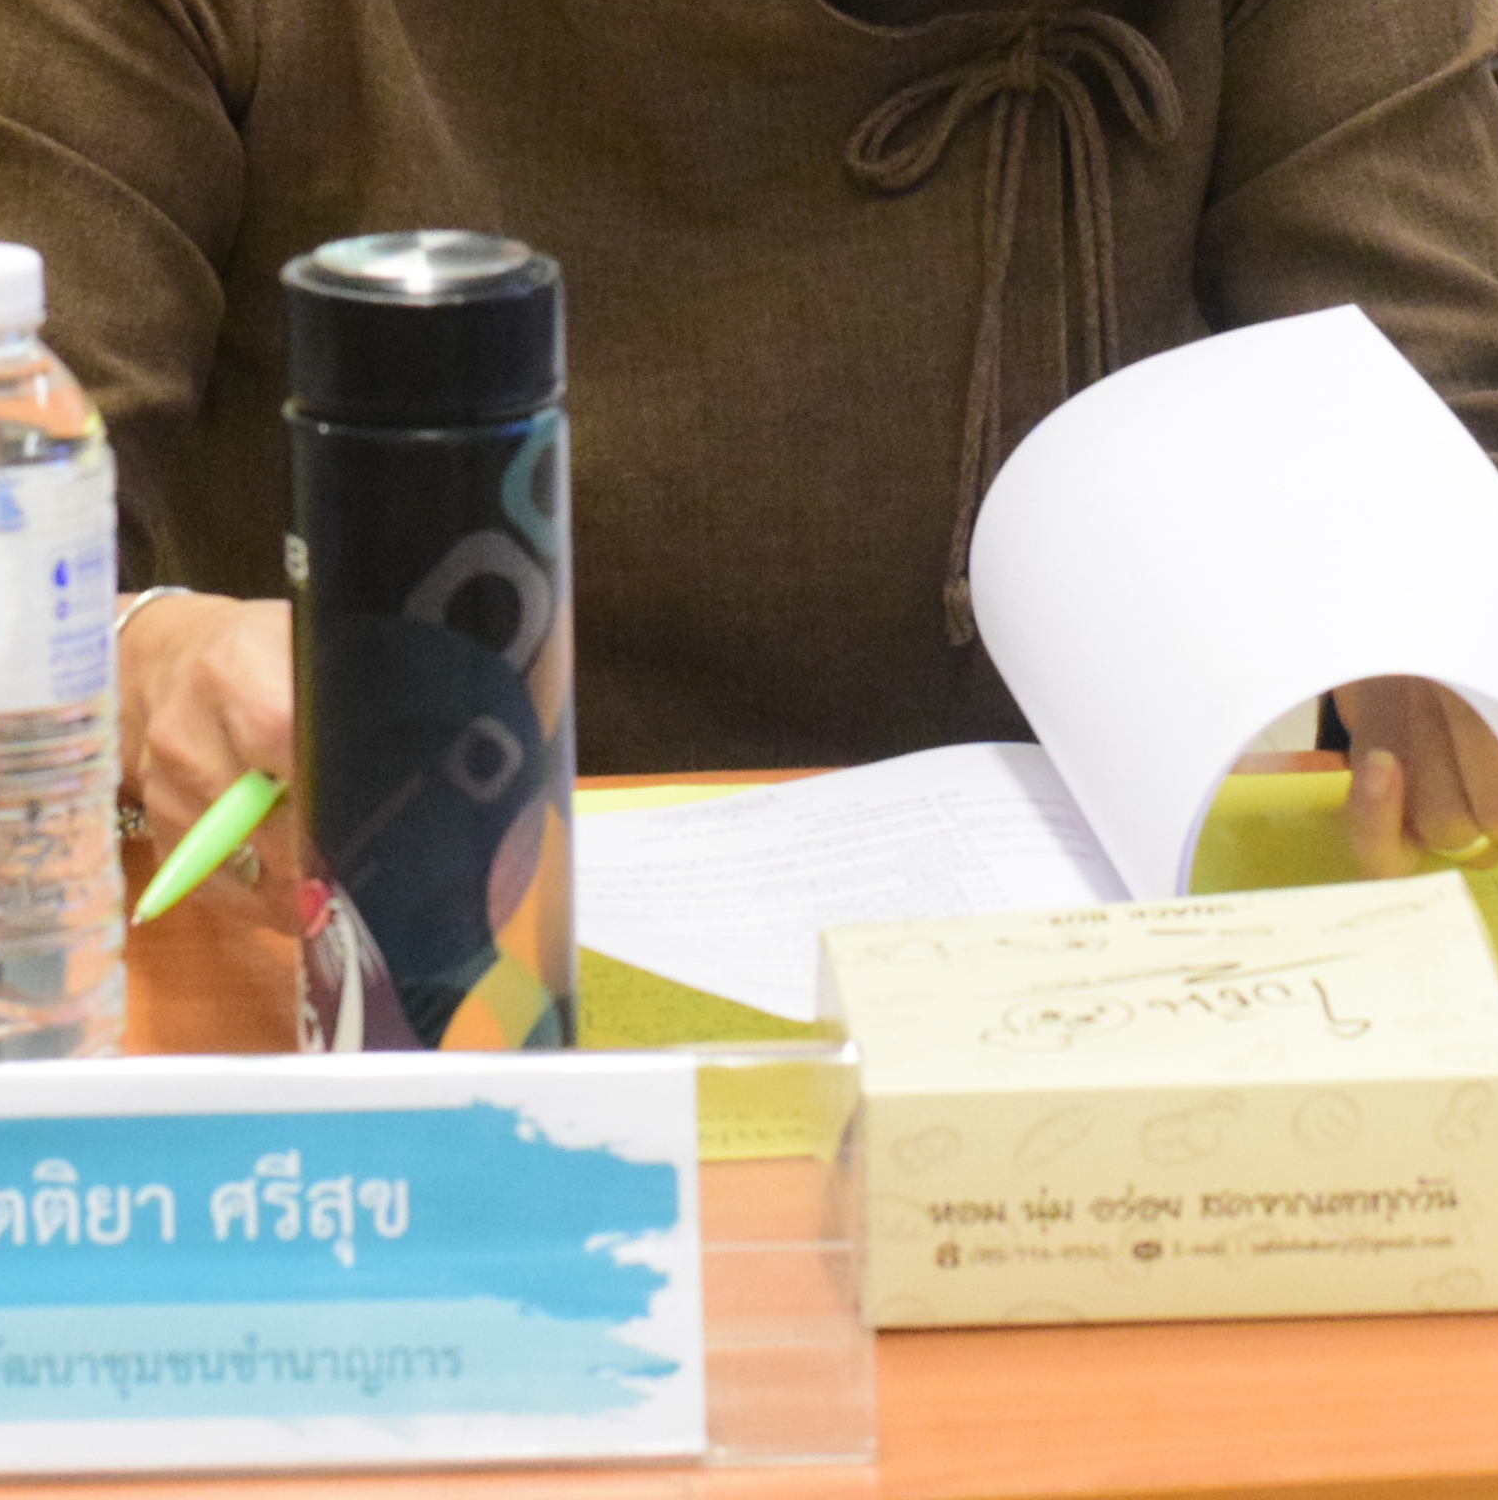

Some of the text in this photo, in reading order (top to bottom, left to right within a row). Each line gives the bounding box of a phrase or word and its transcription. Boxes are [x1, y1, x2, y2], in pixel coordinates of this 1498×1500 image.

[209, 1149, 409, 1269] ศรีสุข
[1087, 1182, 1183, 1225] อร่อย
